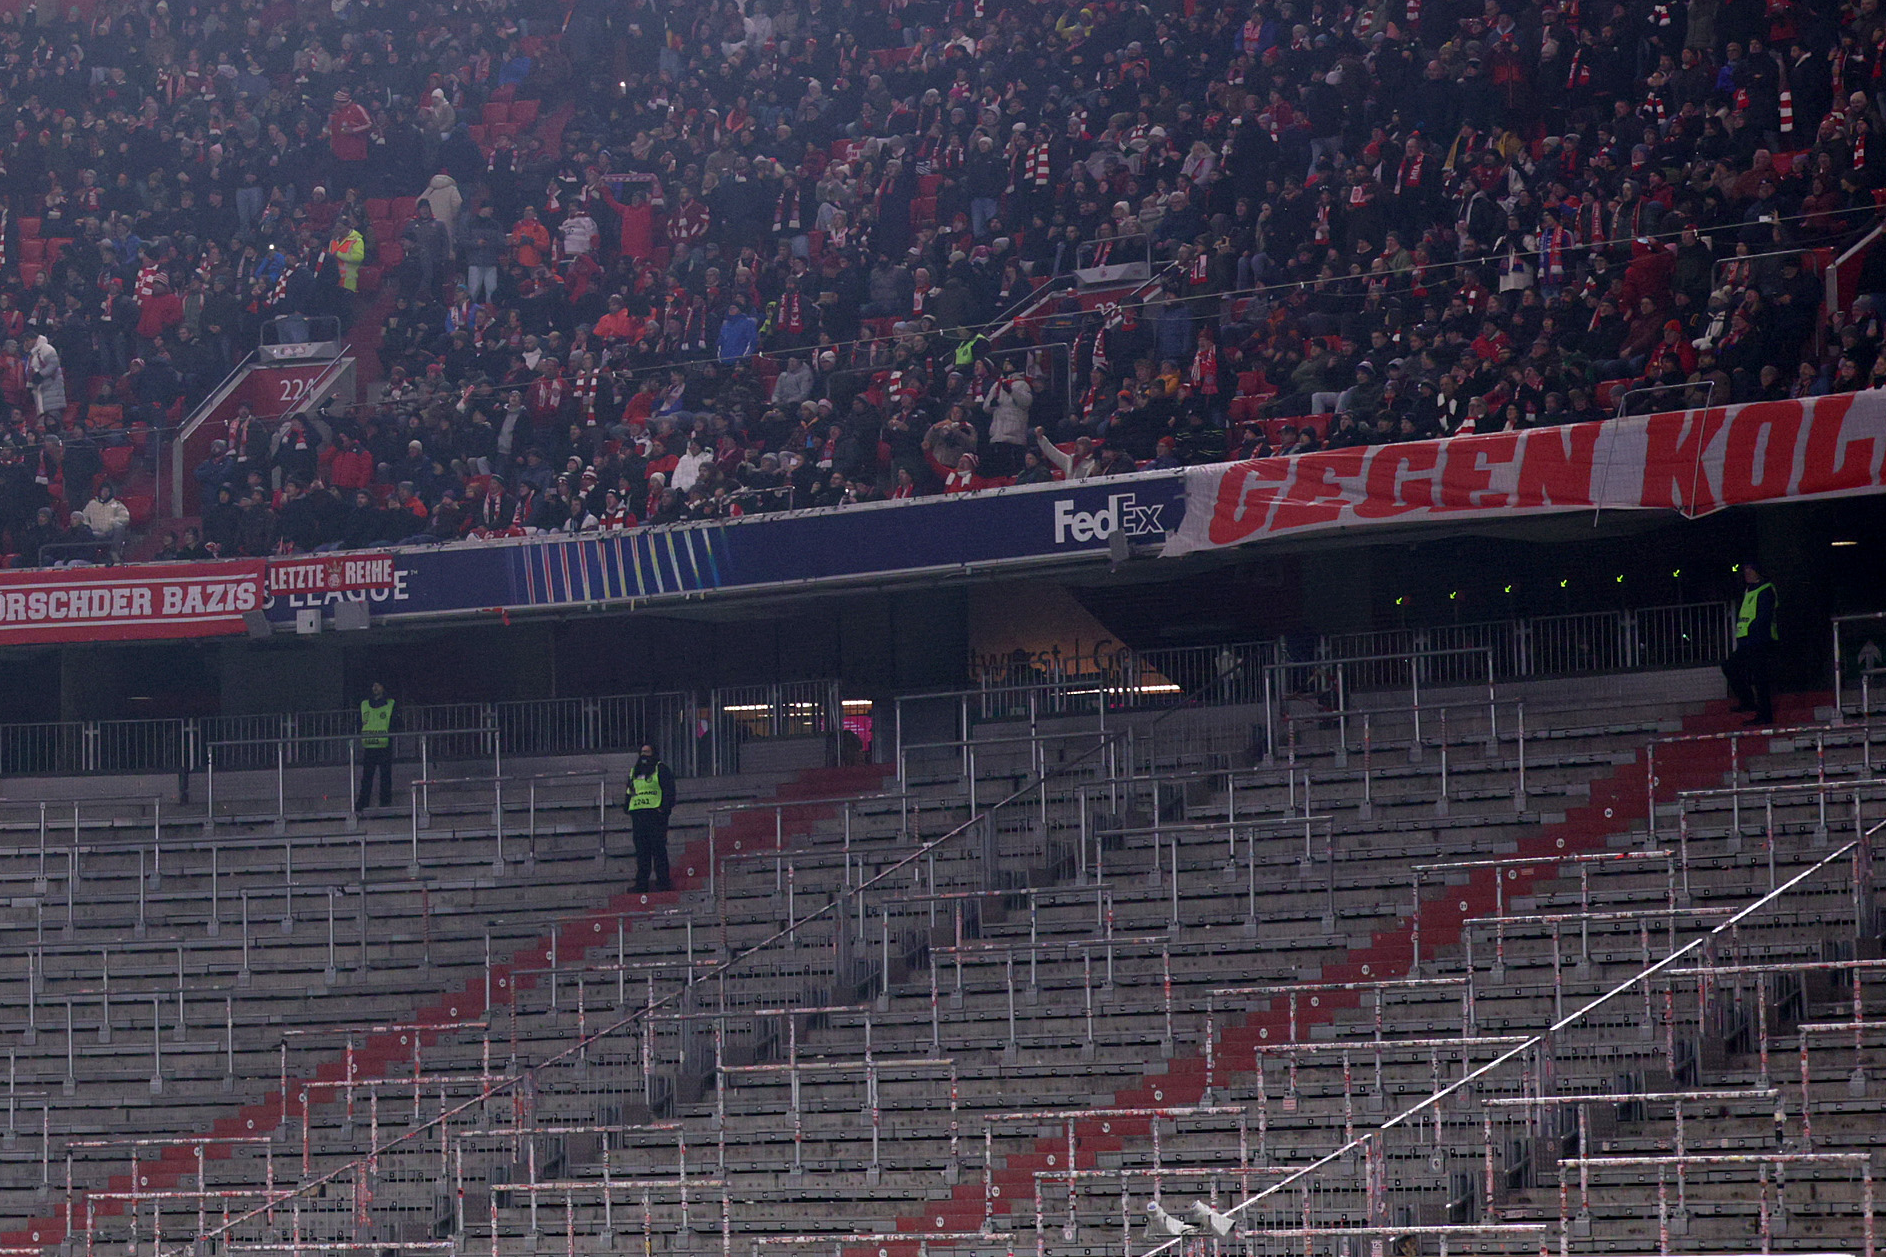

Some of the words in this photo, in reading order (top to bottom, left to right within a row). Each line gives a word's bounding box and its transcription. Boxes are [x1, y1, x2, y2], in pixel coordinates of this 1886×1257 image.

[1208, 420, 1605, 544] GEGEN
[1639, 394, 1886, 517] KOL
[1054, 492, 1166, 544] FedEx
[270, 564, 325, 591] LETZTE
[345, 559, 393, 585] REIHE
[162, 581, 257, 615] BAZIS
